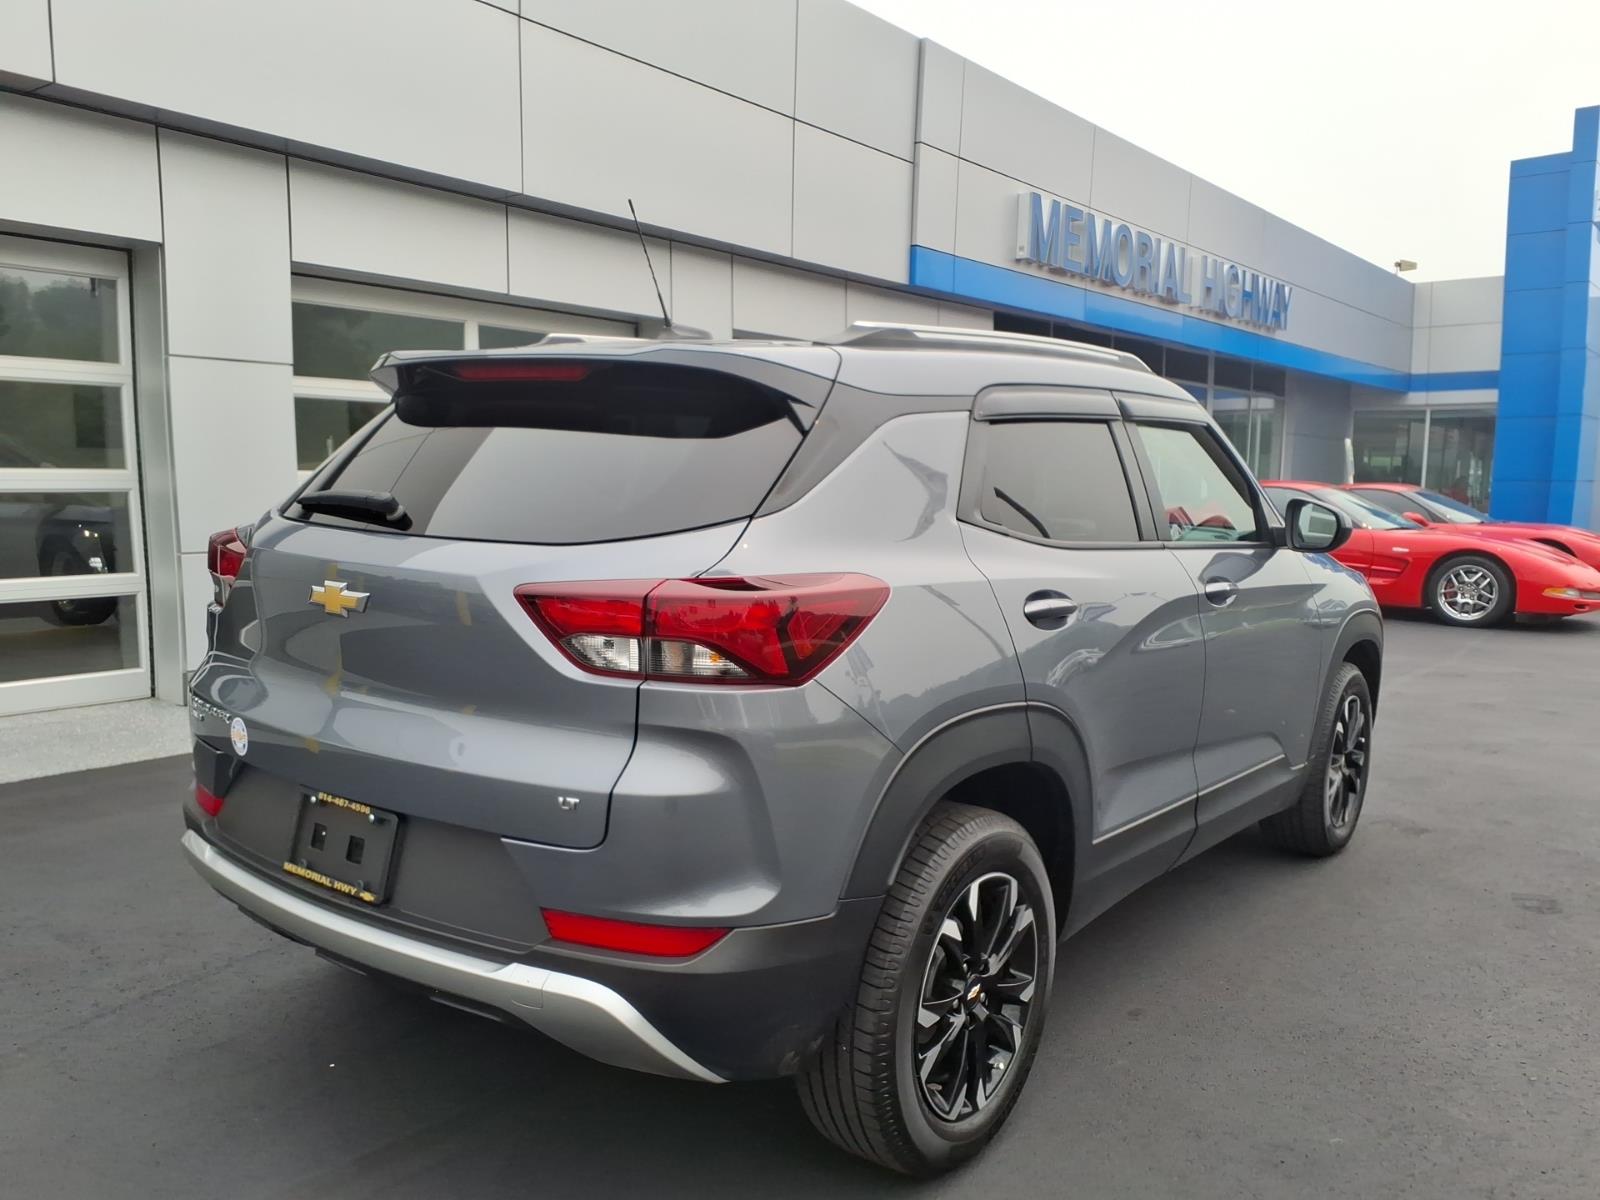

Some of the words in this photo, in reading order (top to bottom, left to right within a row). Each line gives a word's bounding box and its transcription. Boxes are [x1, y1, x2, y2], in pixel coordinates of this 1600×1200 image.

[1019, 191, 1192, 305] MEMORIAL
[1199, 254, 1293, 330] HIGHWAY
[557, 796, 580, 811] LT
[283, 861, 332, 887] MEMORIAL
[333, 880, 358, 896] HWY
